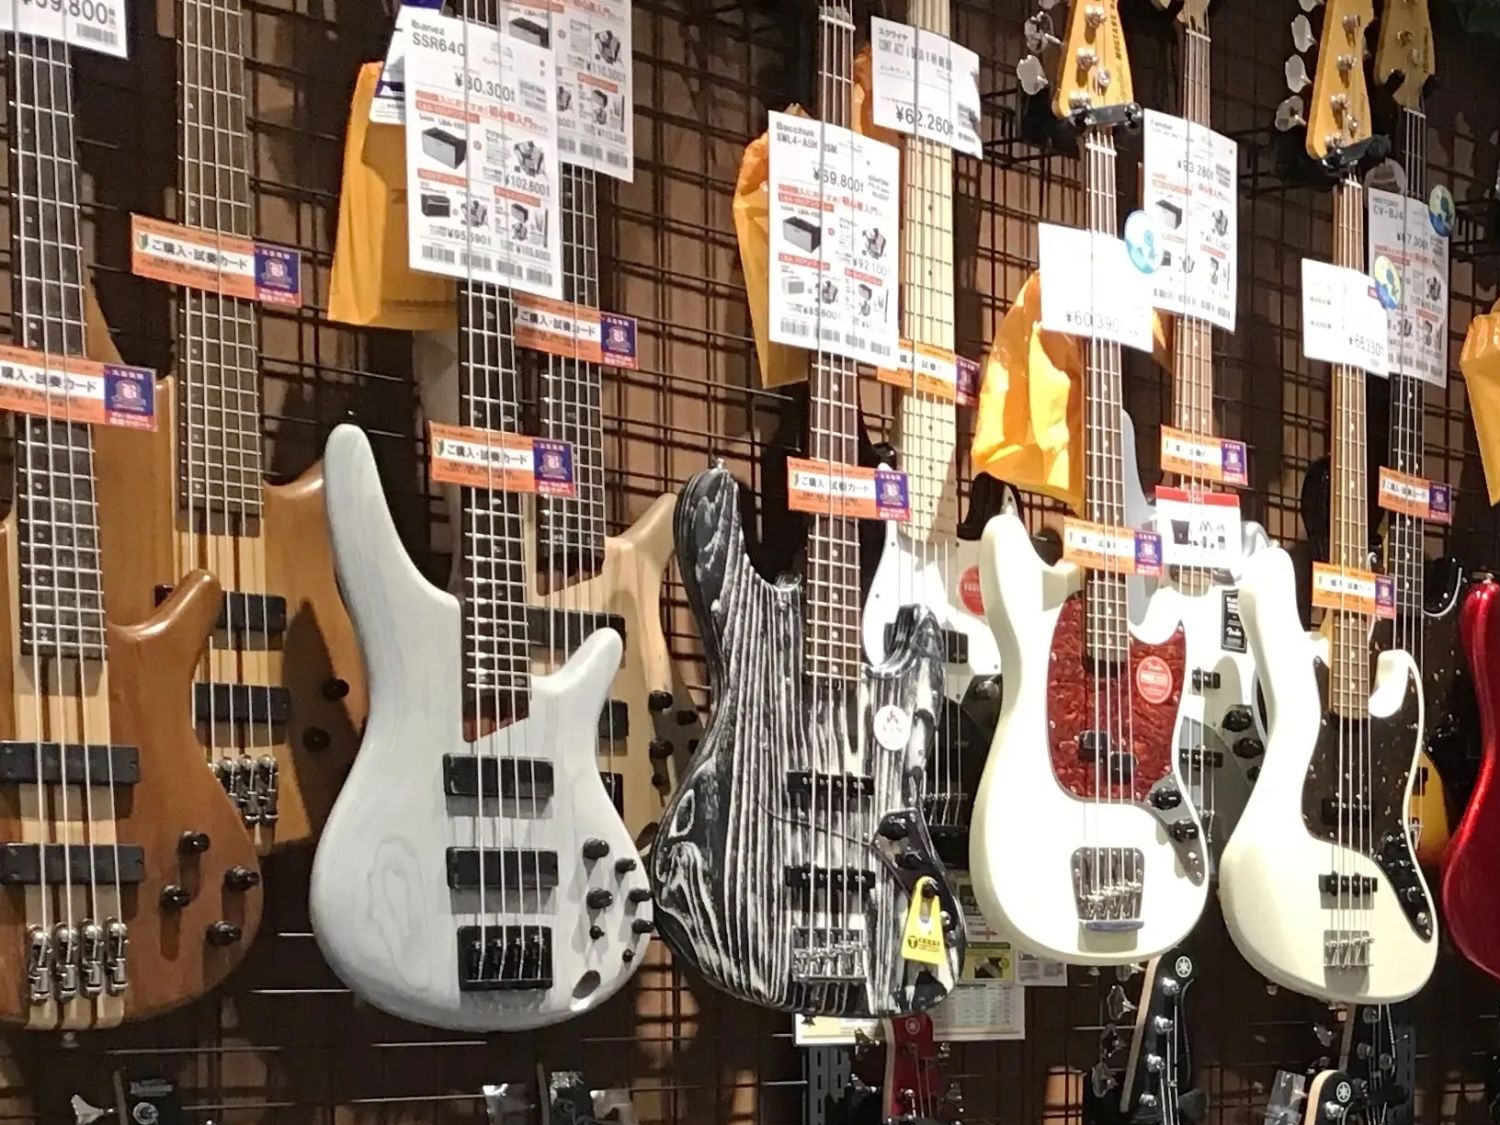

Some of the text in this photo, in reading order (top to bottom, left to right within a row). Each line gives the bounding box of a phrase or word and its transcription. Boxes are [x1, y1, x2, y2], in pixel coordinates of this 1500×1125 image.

[151, 239, 249, 269] ご購入・試奏カード
